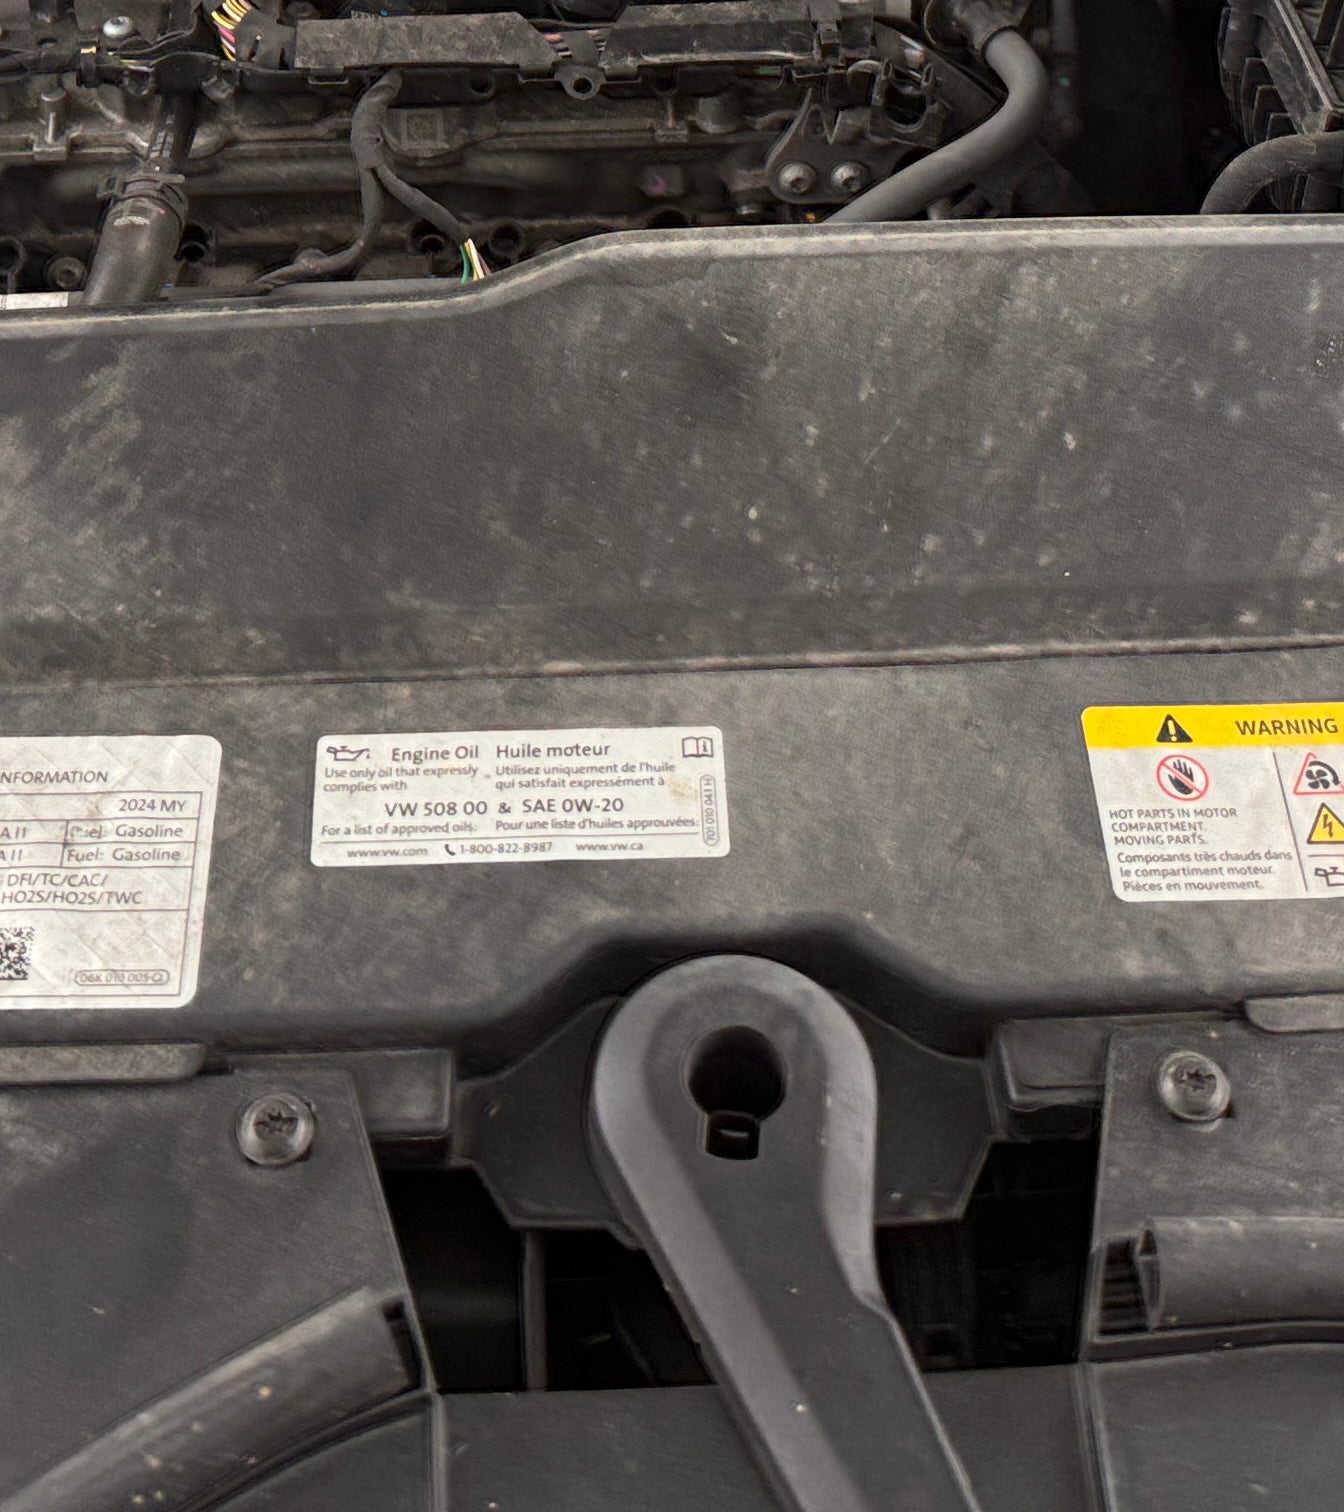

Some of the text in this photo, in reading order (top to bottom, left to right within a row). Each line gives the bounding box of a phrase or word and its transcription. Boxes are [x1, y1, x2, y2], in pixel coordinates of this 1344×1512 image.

[1235, 718, 1338, 736] WARNING
[392, 745, 479, 765] Engine Oil
[496, 744, 610, 758] Huile moteur
[324, 764, 479, 780] Use only oil that expressly
[496, 765, 540, 776] Utilisez
[544, 763, 618, 776] uniquement
[622, 762, 637, 773] de
[380, 780, 407, 791] with
[496, 776, 665, 790] qui satisfait expressément à
[119, 798, 187, 812] 2024 MY
[385, 797, 624, 817] VW 508 00 & SAE 0W-20
[1109, 807, 1237, 819] HOT PARTS IN MOTOR
[115, 823, 184, 838] Gasoline
[321, 824, 341, 835] For
[344, 826, 351, 835] a
[354, 824, 372, 835] list
[376, 823, 389, 834] of
[392, 822, 449, 837] approved
[496, 820, 522, 831] Pour
[526, 821, 549, 830] une
[551, 818, 576, 829] liste
[576, 842, 644, 852] www.vw.ca
[1114, 835, 1164, 846] MOVING
[66, 847, 181, 862] Fuel: Gasoline
[347, 847, 428, 858] www.vw.com
[460, 842, 552, 854] 1-800-822-8987
[1117, 849, 1292, 865] Composants très chauds dans
[1120, 866, 1224, 879] le compartiment
[7, 873, 108, 887] DFI/TC/CAC/
[1123, 880, 1162, 892] Pièces
[1166, 882, 1180, 890] en
